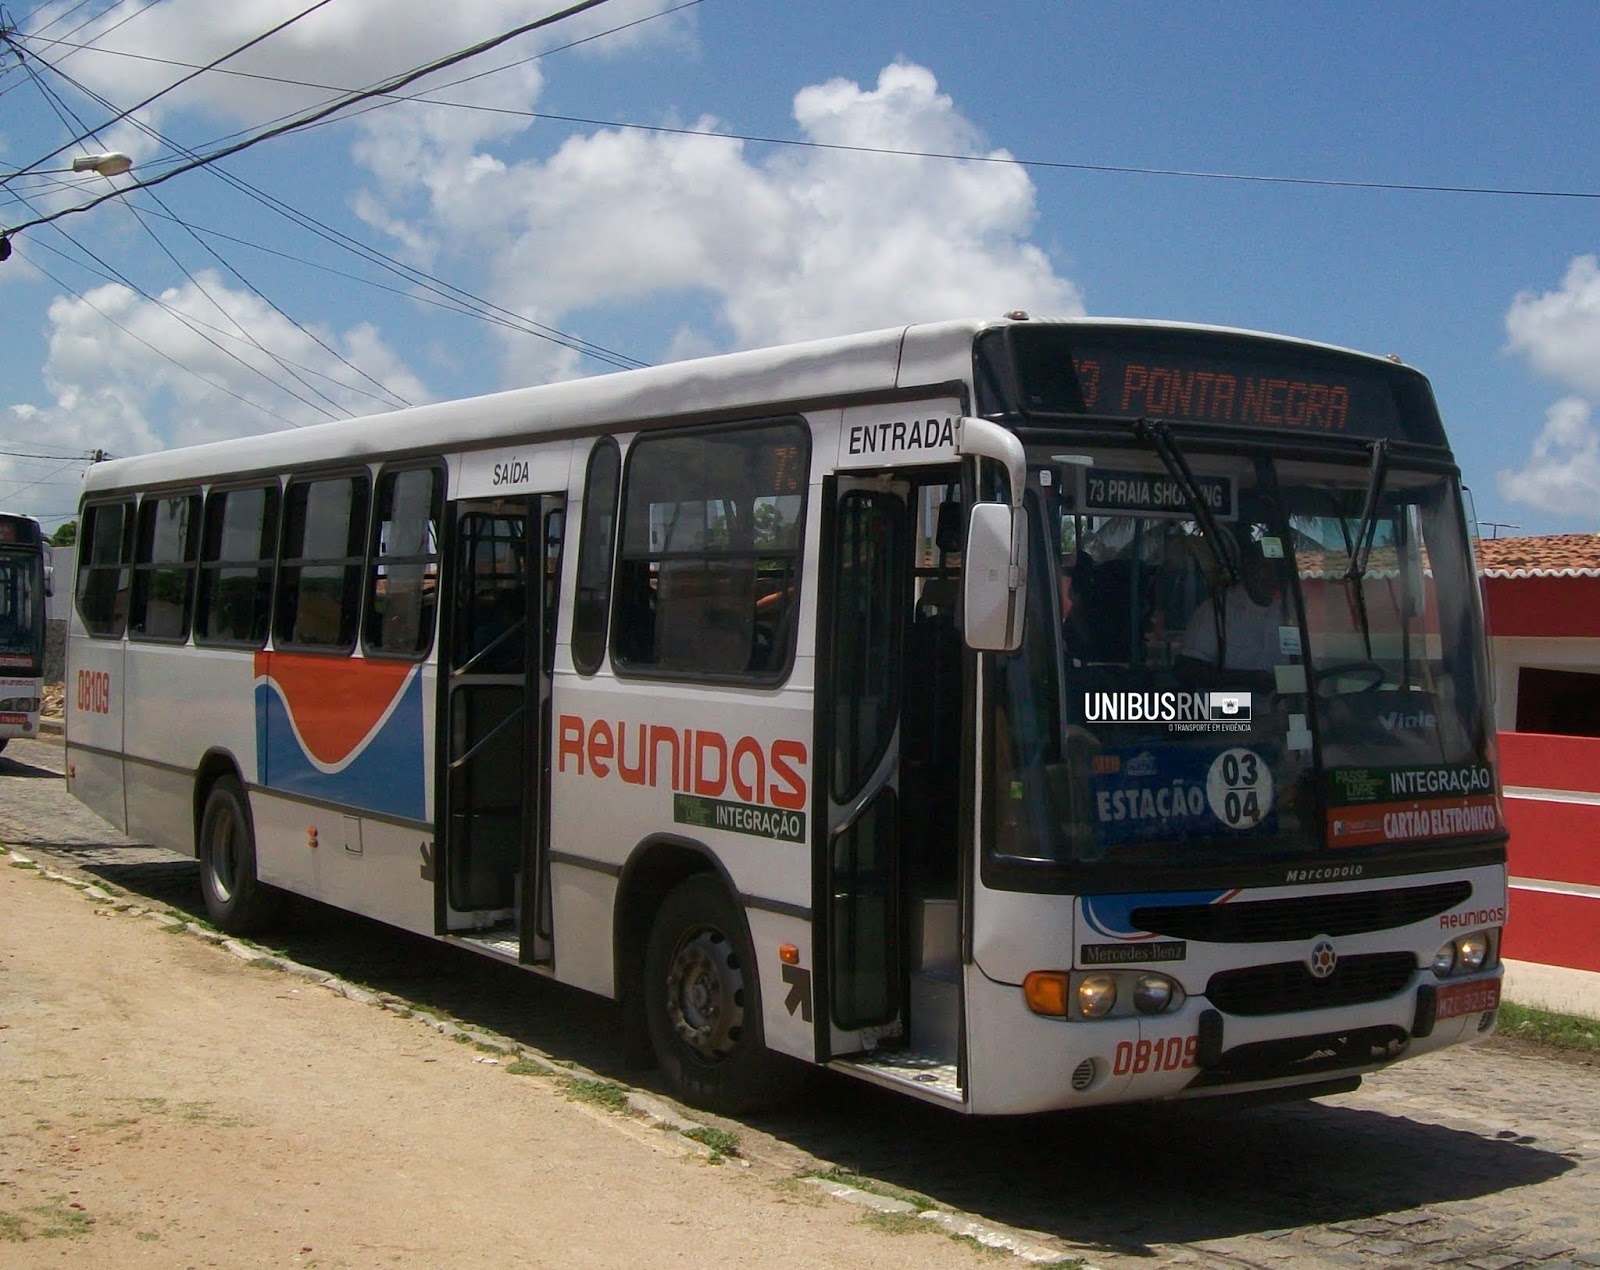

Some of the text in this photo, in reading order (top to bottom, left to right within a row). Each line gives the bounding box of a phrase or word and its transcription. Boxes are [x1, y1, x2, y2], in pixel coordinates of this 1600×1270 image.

[1072, 359, 1349, 430] 3 PONTA NEGRA
[849, 418, 954, 454] ENTRADA
[493, 455, 529, 486] SAÍDA
[1089, 478, 1105, 502] 73
[1108, 478, 1150, 505] PRAIA
[78, 669, 109, 714] 08109
[1222, 753, 1258, 787] 03
[1335, 769, 1369, 784] PASSE
[1390, 765, 1490, 795] INTEGRAÇÃO
[1096, 778, 1204, 824] ESTAÇÃO
[1346, 784, 1376, 797] LIVRE
[716, 806, 800, 839] INTEGRAÇÃO
[1224, 791, 1260, 825] 04
[1383, 804, 1430, 840] CARTÃO
[1430, 800, 1496, 835] ELETRÔNICO
[1286, 864, 1363, 882] Marcopolo
[1086, 945, 1183, 962] Mercedes-Benz
[1113, 1035, 1199, 1076] 08109
